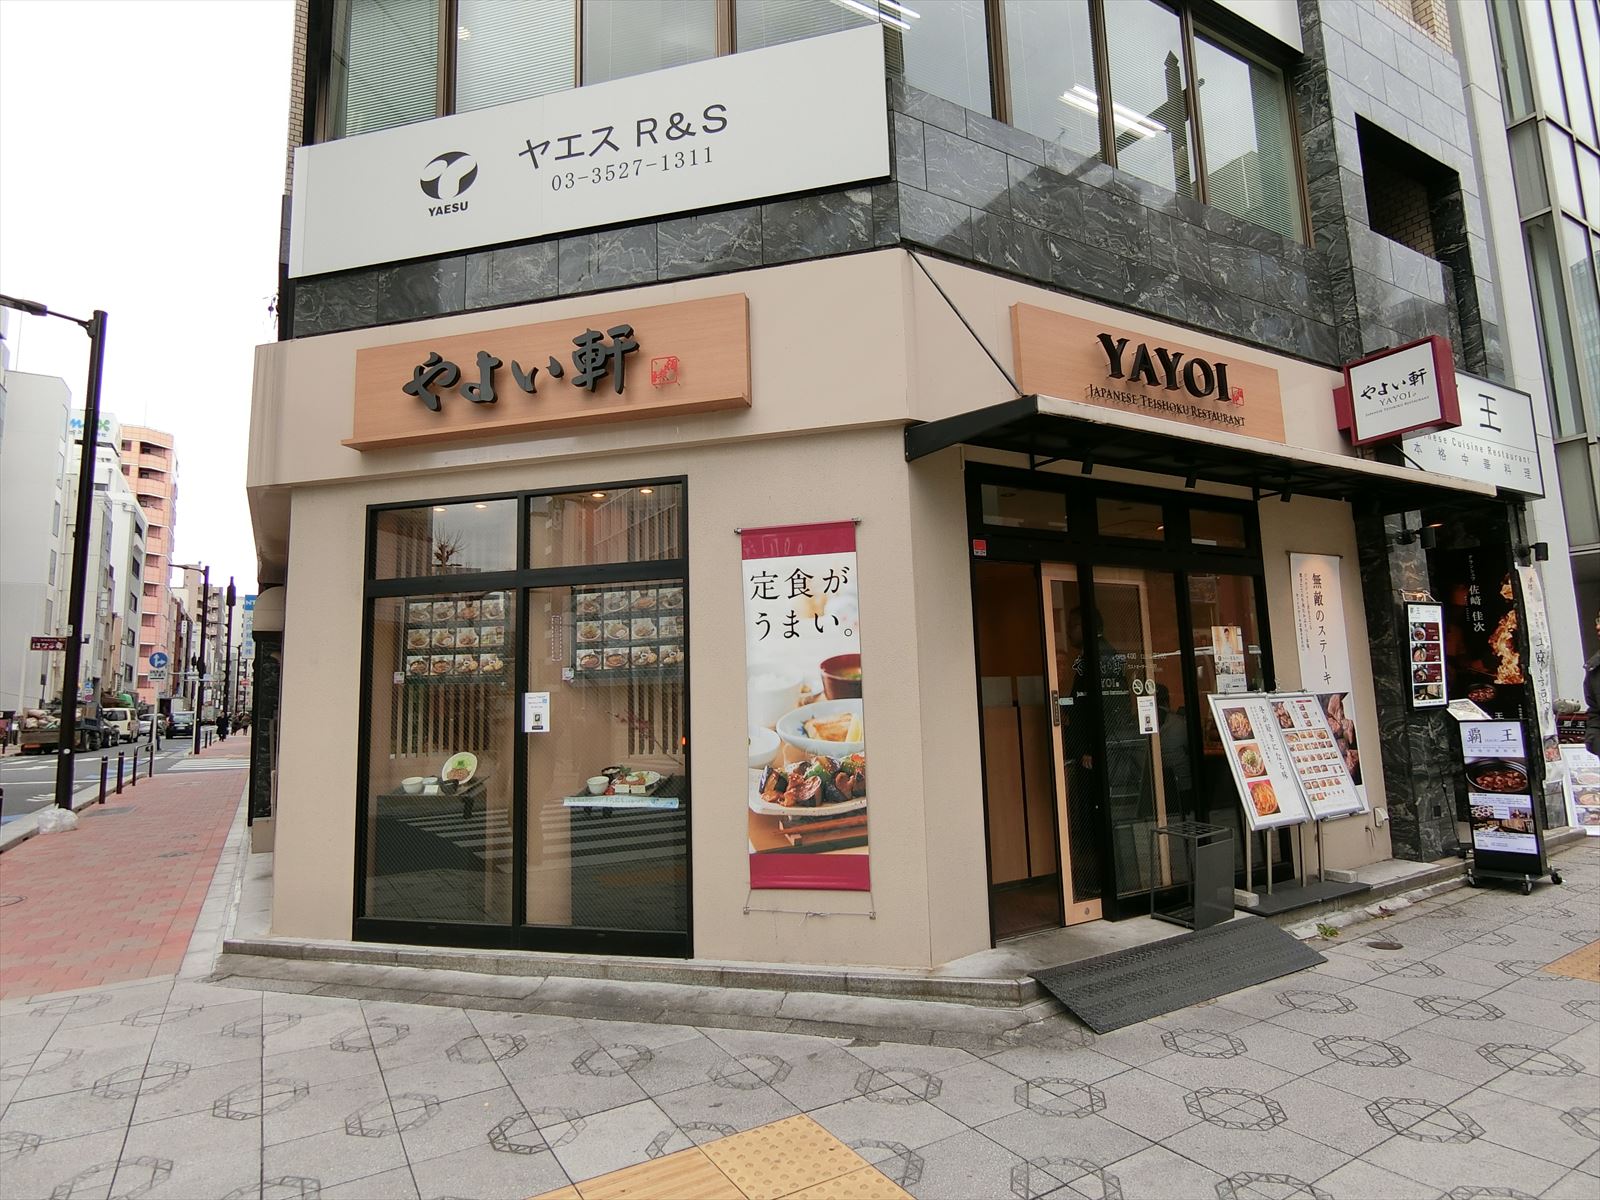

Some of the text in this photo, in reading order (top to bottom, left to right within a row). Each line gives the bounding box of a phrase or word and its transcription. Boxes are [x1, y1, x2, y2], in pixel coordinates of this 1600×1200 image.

[518, 104, 728, 170] ヤエス R&S
[551, 146, 713, 192] 03-3527-1311
[428, 201, 469, 217] YAESU
[402, 324, 640, 412] やよい軒
[1096, 332, 1232, 402] YAYOI
[1361, 368, 1428, 400] やよい軒
[1088, 384, 1246, 426] JAPANESE TEISHOKU RESTAURANT
[1379, 391, 1412, 407] YAYOI
[1451, 436, 1485, 453] Cuisine
[1486, 445, 1531, 465] Restaurant
[749, 566, 850, 601] 定食が
[754, 609, 853, 641] うまい。
[1311, 572, 1333, 686] 無敵のステーキ
